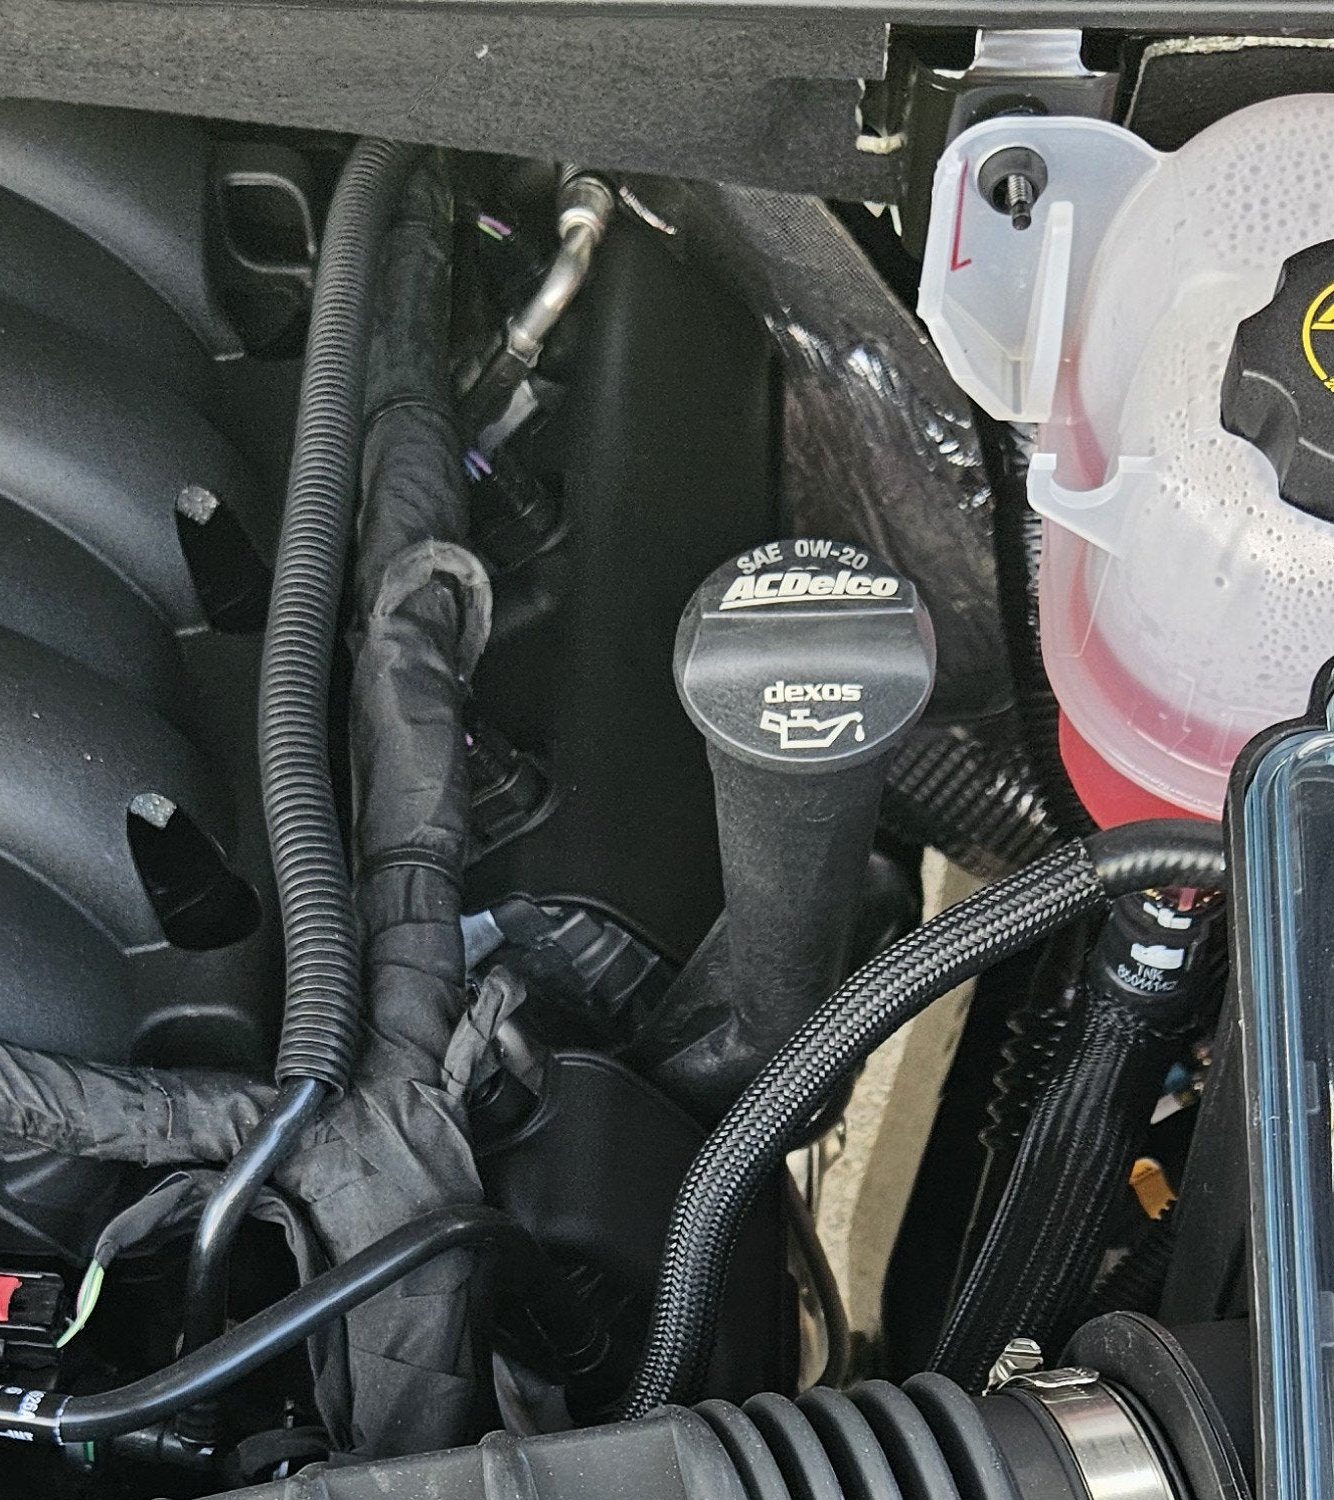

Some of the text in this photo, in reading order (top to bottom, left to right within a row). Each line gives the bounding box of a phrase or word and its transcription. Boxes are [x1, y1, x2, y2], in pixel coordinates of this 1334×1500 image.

[737, 542, 784, 575] SAE
[721, 571, 900, 603] ACDelco
[764, 680, 863, 704] dexos
